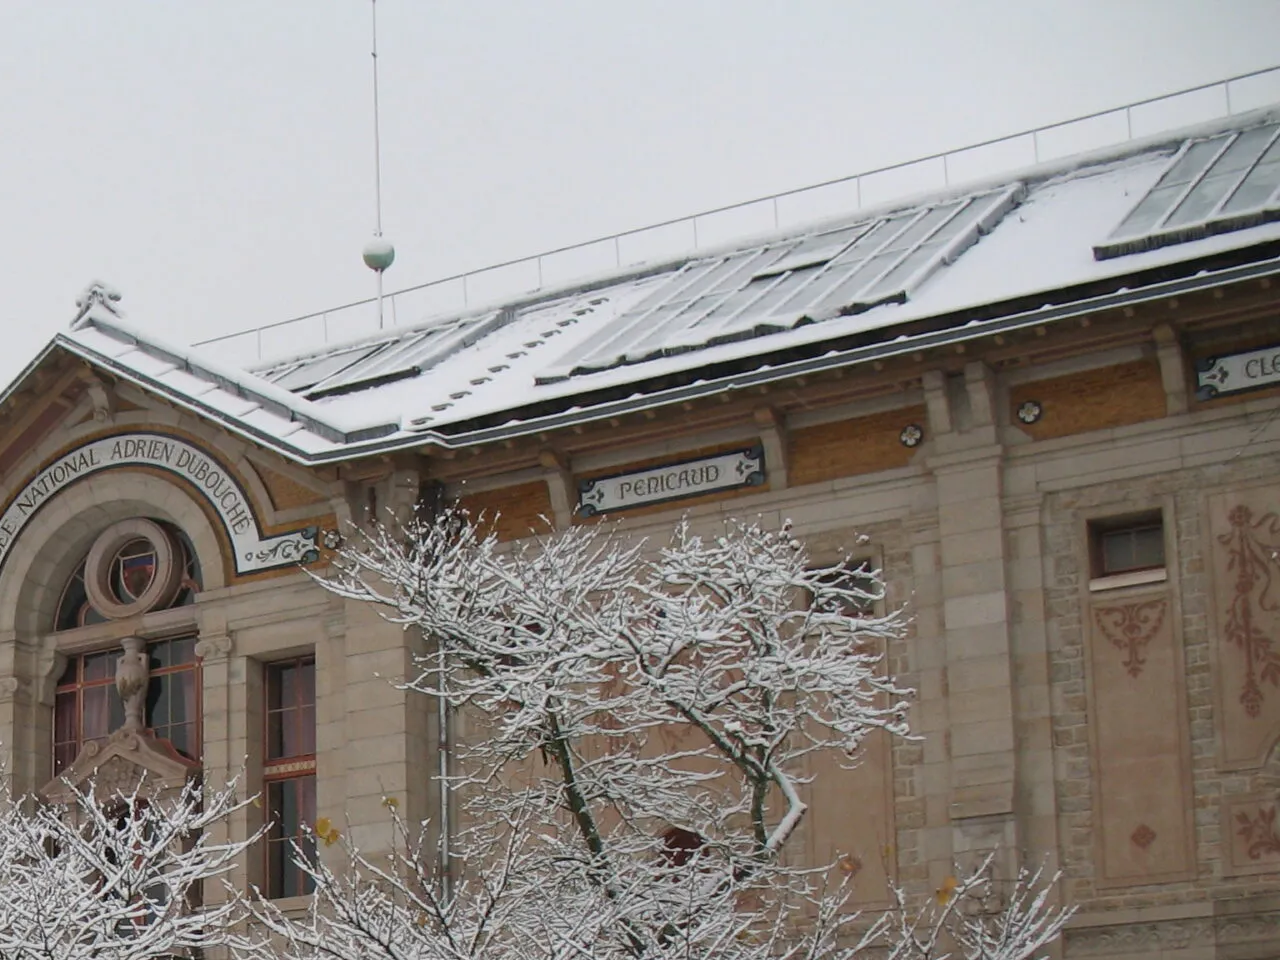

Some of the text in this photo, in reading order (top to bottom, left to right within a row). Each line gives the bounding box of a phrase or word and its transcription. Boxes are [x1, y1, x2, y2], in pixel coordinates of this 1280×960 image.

[16, 447, 100, 517] NATIONAL
[111, 439, 175, 462] ADRIEN
[176, 447, 255, 536] DUBOUCHÉ
[619, 464, 720, 500] PENICAUD
